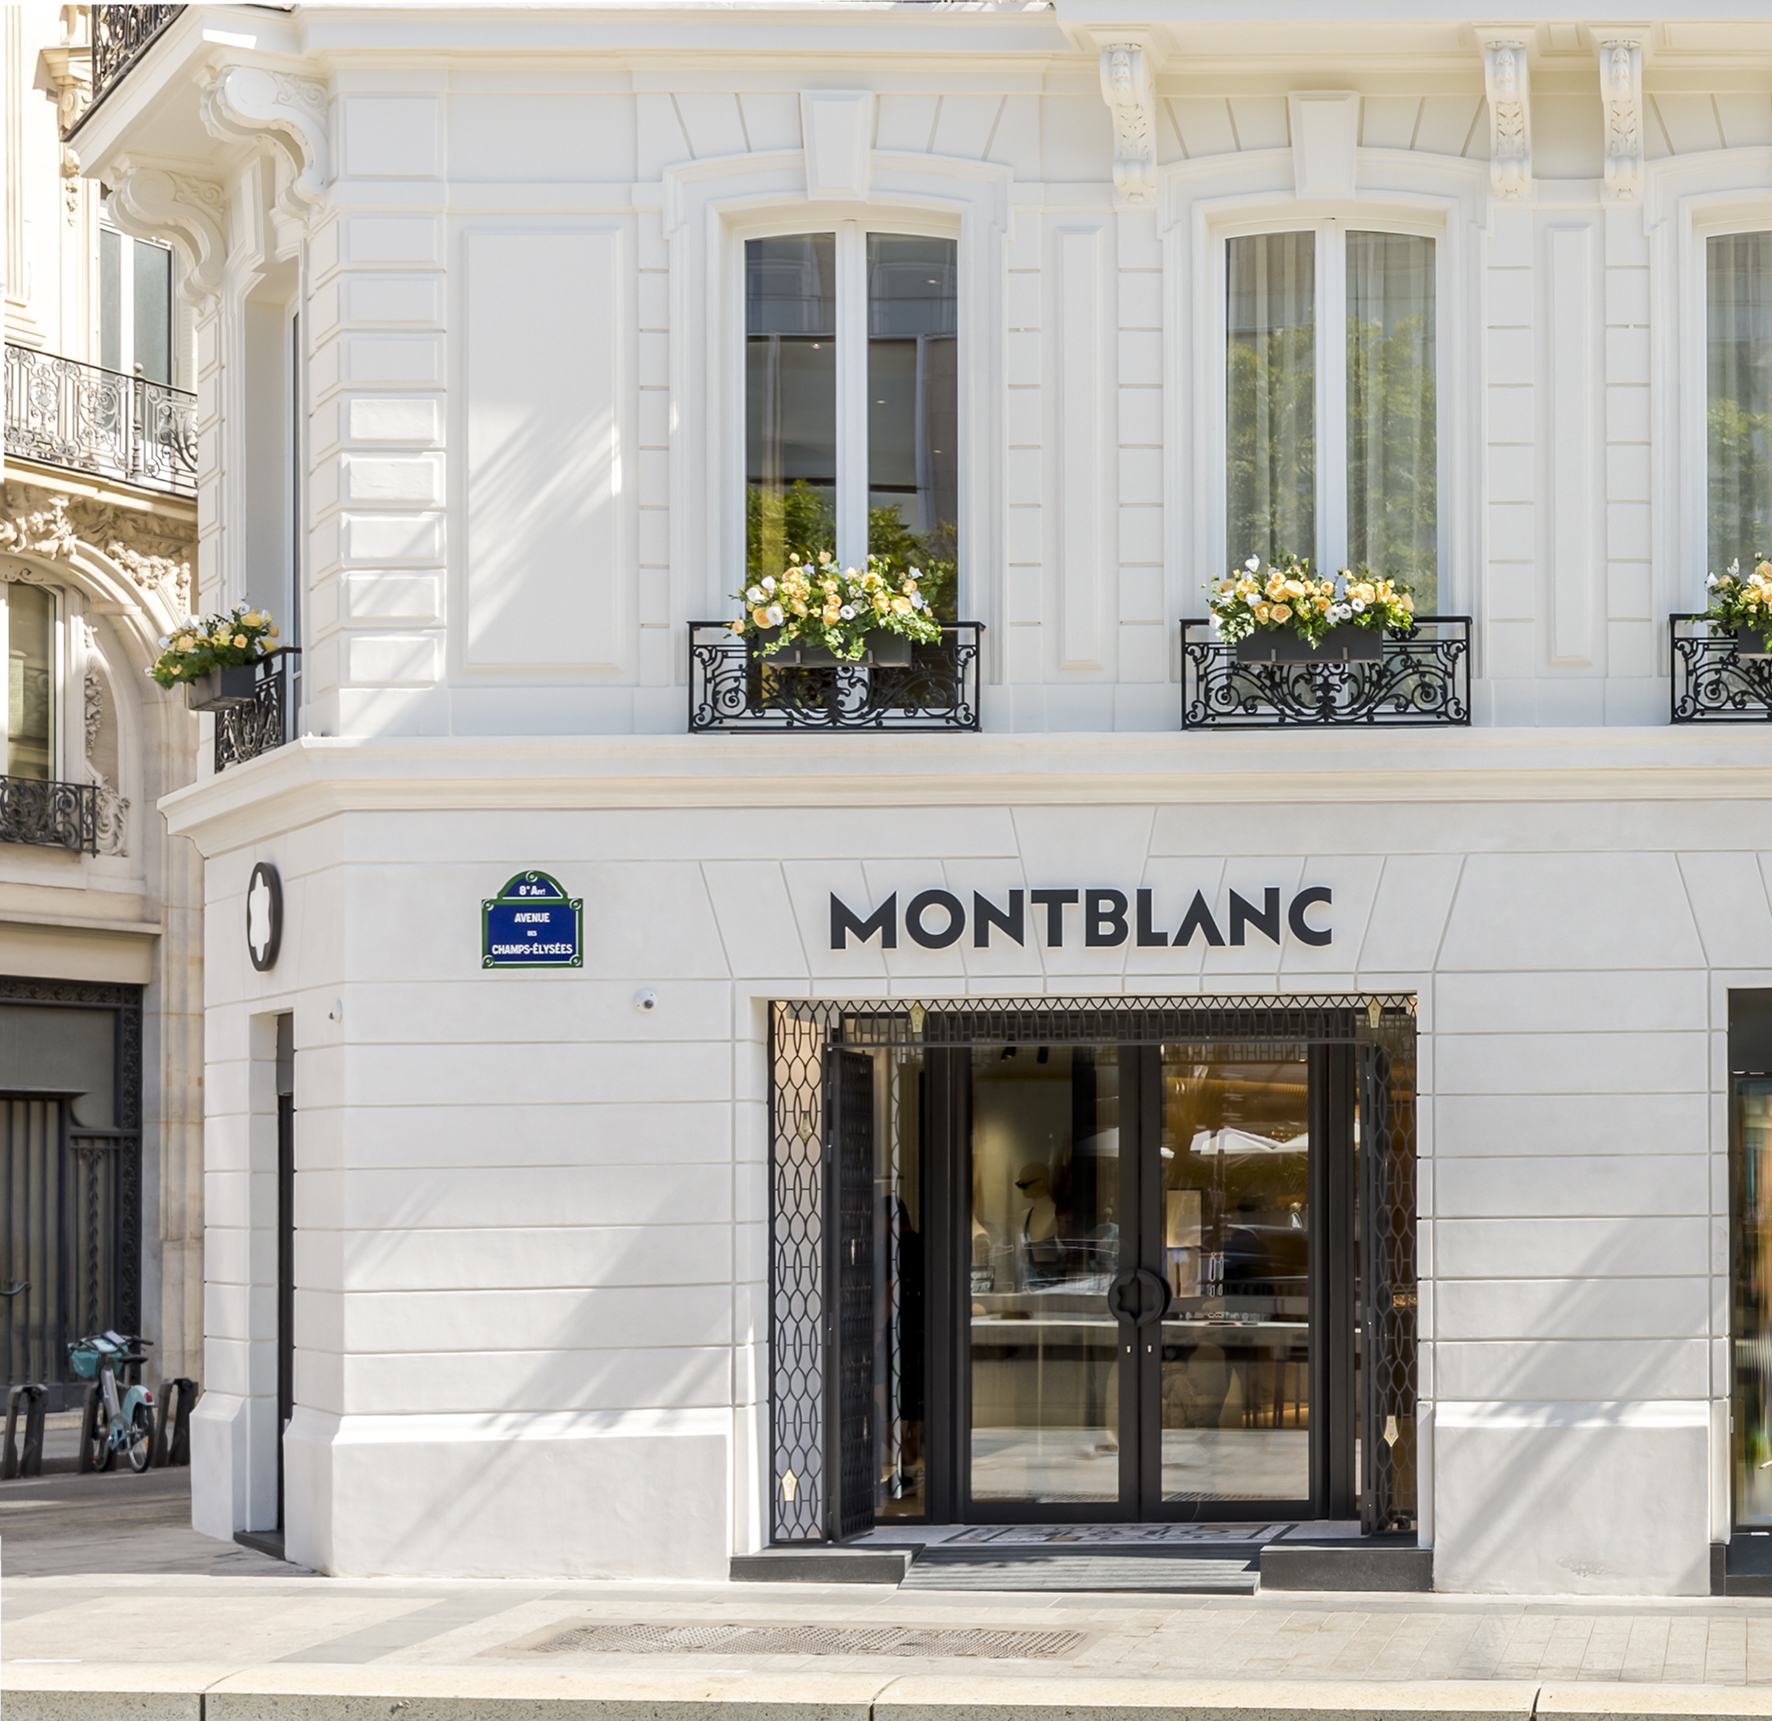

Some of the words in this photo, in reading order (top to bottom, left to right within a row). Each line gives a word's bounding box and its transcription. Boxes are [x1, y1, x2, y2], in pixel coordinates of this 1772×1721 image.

[514, 912, 551, 923] AVENUE
[830, 886, 1333, 949] MONTBLANC
[491, 942, 574, 956] CHAMPS-ÉLYSÉES
